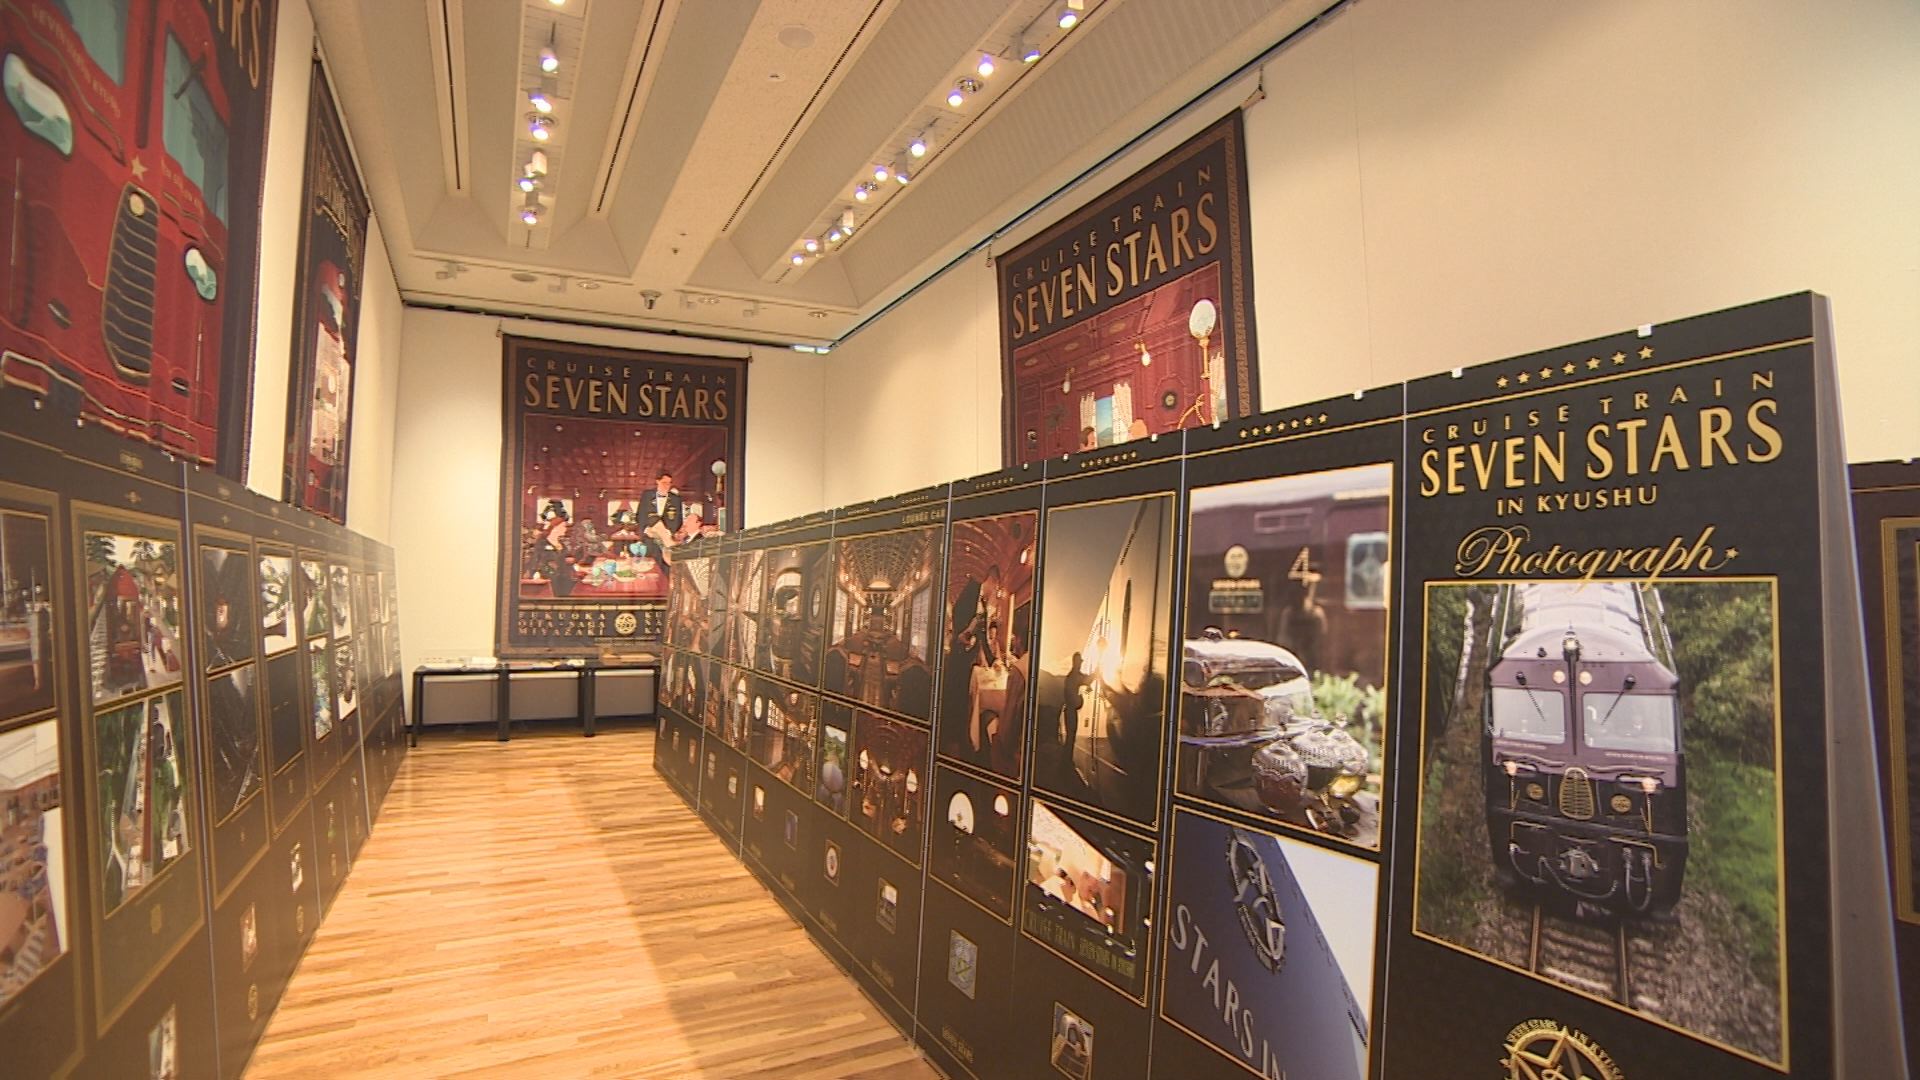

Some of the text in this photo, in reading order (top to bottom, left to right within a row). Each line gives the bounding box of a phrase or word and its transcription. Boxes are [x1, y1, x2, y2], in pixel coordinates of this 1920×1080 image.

[1012, 165, 1212, 288] CRUISE TRAIN
[1012, 192, 1219, 341] SEVEN STARS
[524, 373, 729, 421] SEVEN STARS
[527, 356, 728, 385] CRUISE TRAIN
[1423, 371, 1774, 444] CRUISE TRAIN
[1420, 399, 1784, 498] SEVEN STARS
[1496, 485, 1658, 516] IN KYUSHU
[1454, 524, 1734, 593] Photograph
[1170, 904, 1254, 1059] STARS
